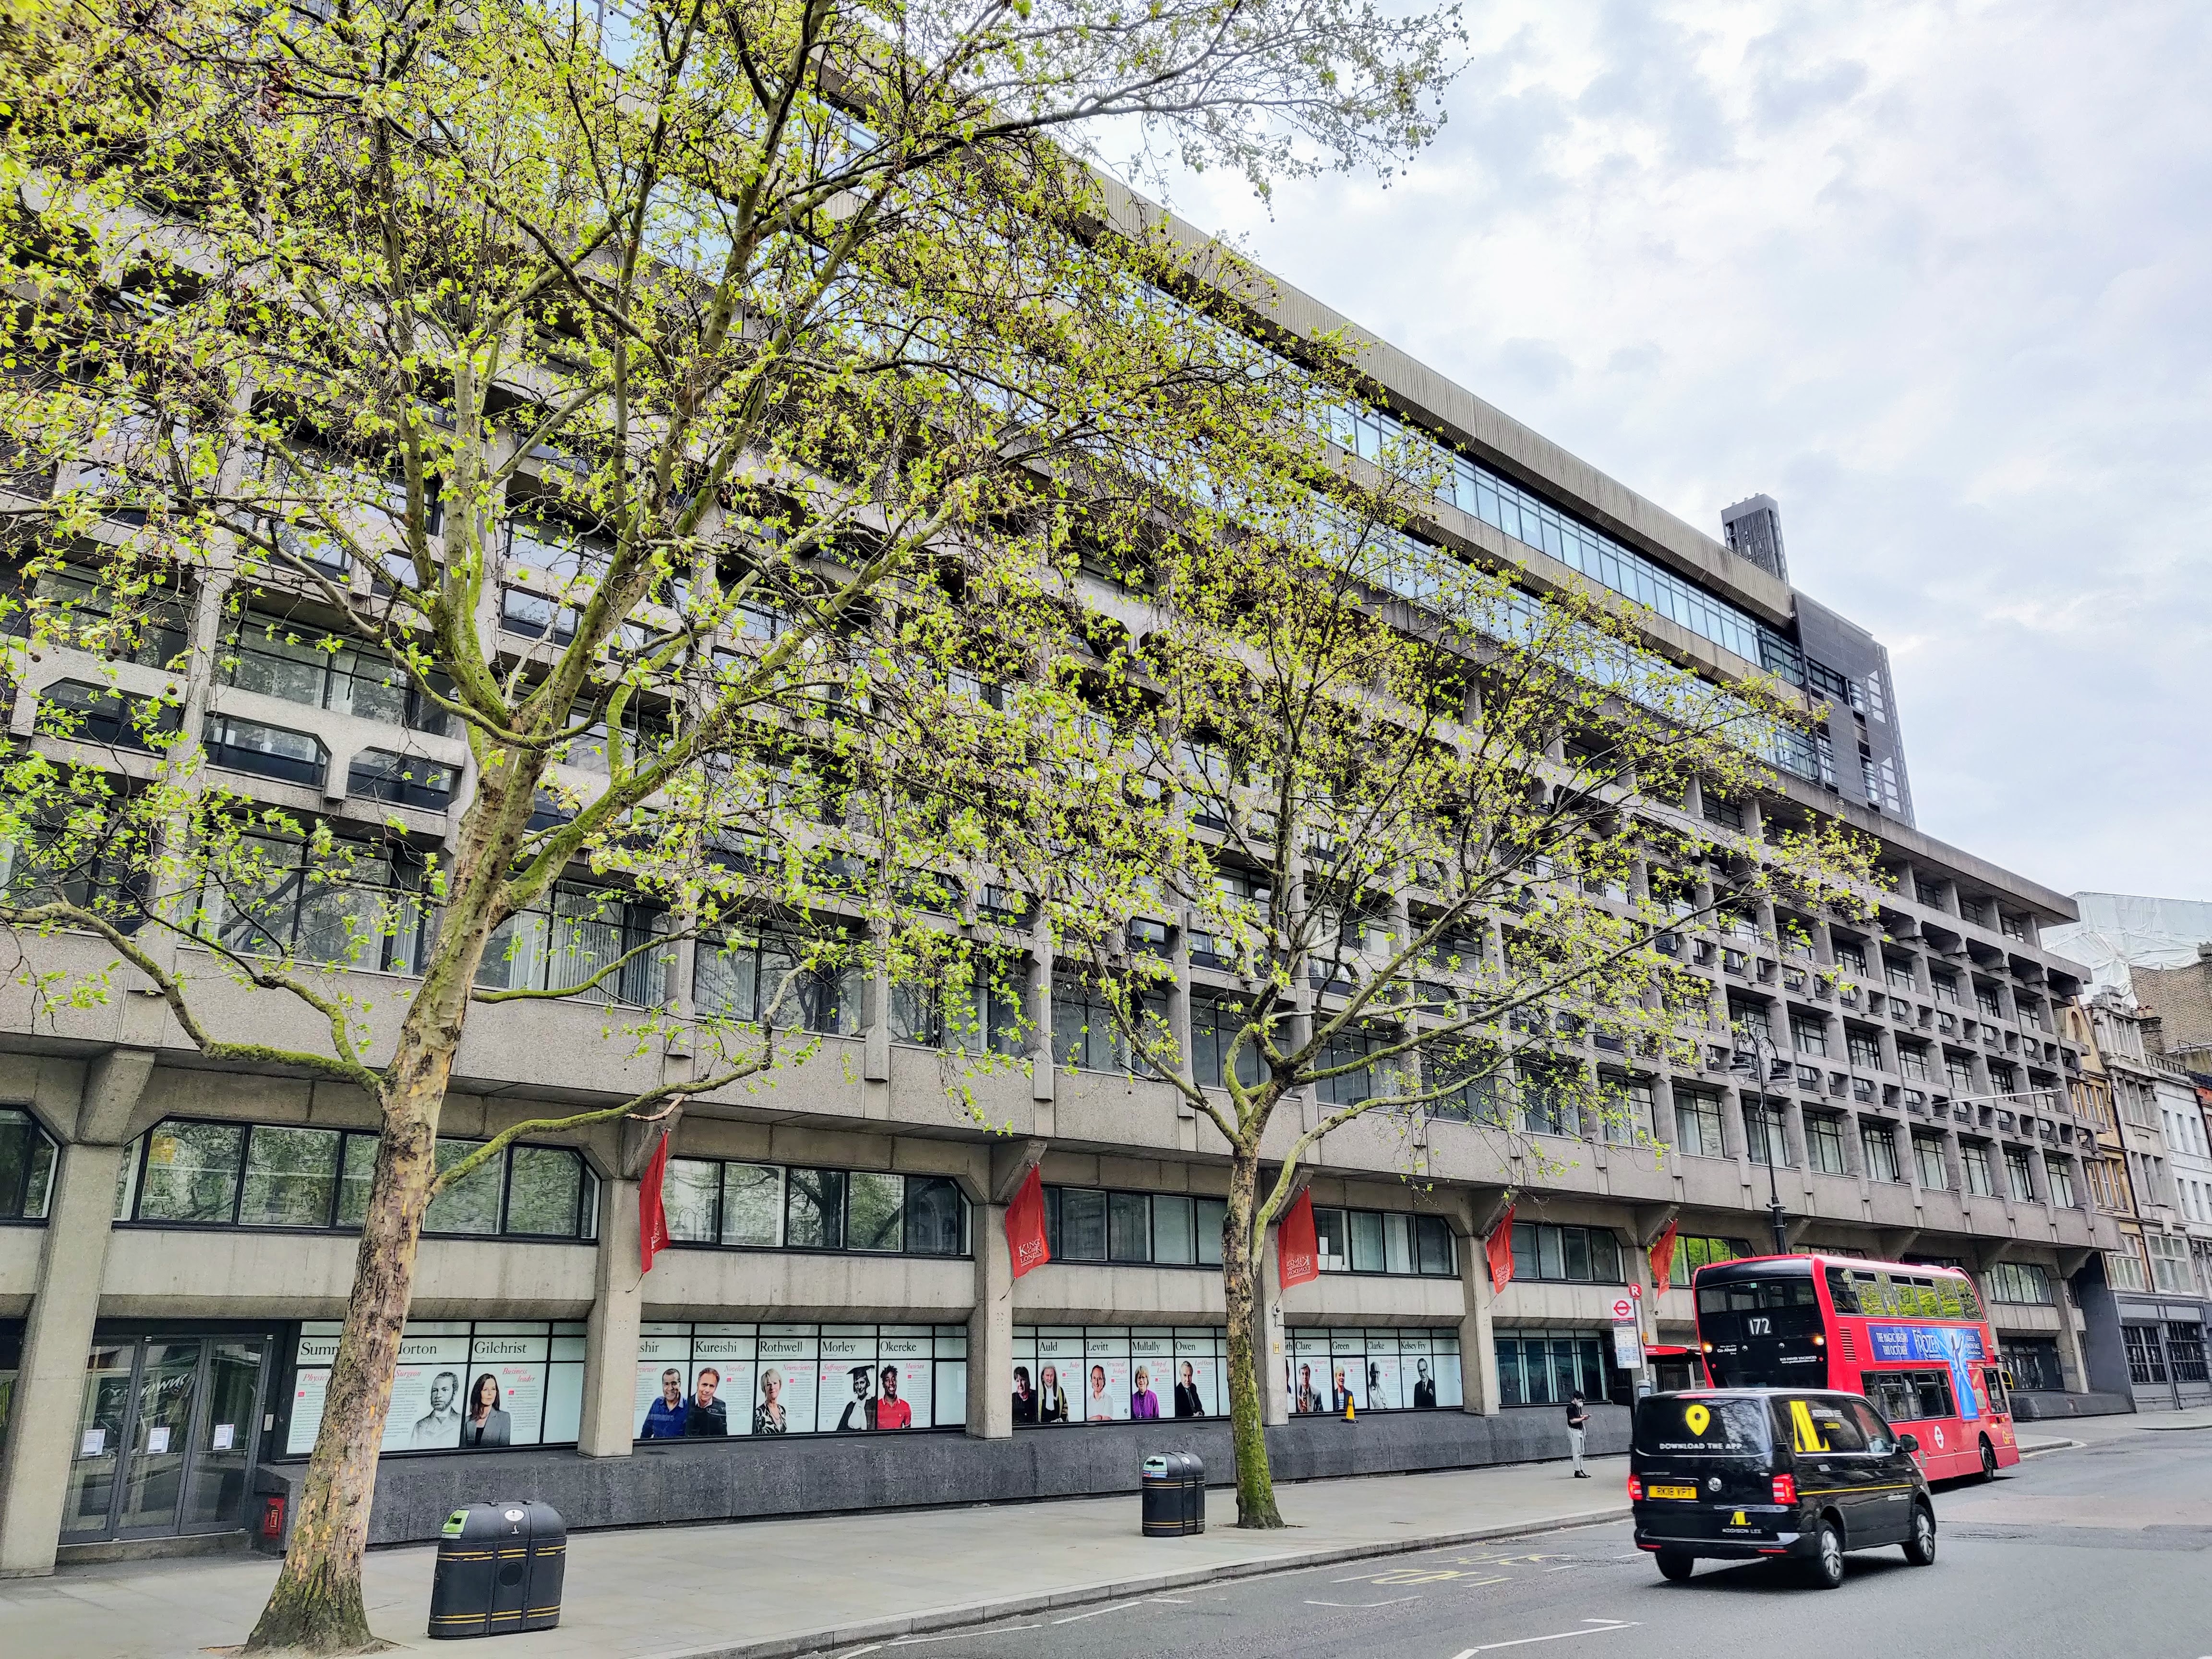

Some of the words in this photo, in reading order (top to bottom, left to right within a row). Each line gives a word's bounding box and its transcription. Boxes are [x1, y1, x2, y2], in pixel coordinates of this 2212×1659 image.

[1631, 1286, 1640, 1296] R
[1749, 1318, 1771, 1335] 172
[474, 1341, 528, 1354] Gilchrist
[638, 1341, 660, 1353] shir
[695, 1341, 737, 1353] Kureishi
[759, 1341, 803, 1352] Rothwell
[822, 1341, 856, 1354] Morley
[880, 1341, 917, 1352] Okereke
[1039, 1341, 1058, 1351] Auld
[1087, 1341, 1109, 1351] Levitt
[1132, 1341, 1161, 1353] Mullally
[1176, 1341, 1196, 1351] Owen
[1295, 1341, 1311, 1350] Clare
[1332, 1341, 1350, 1350] Green
[1367, 1341, 1385, 1350] Clarke
[1400, 1341, 1417, 1350] Kelsey
[1418, 1341, 1426, 1351] Fry
[1911, 1329, 1942, 1358] FROZEN
[823, 1363, 848, 1371] Suffragette
[395, 1370, 421, 1379] Surgeon
